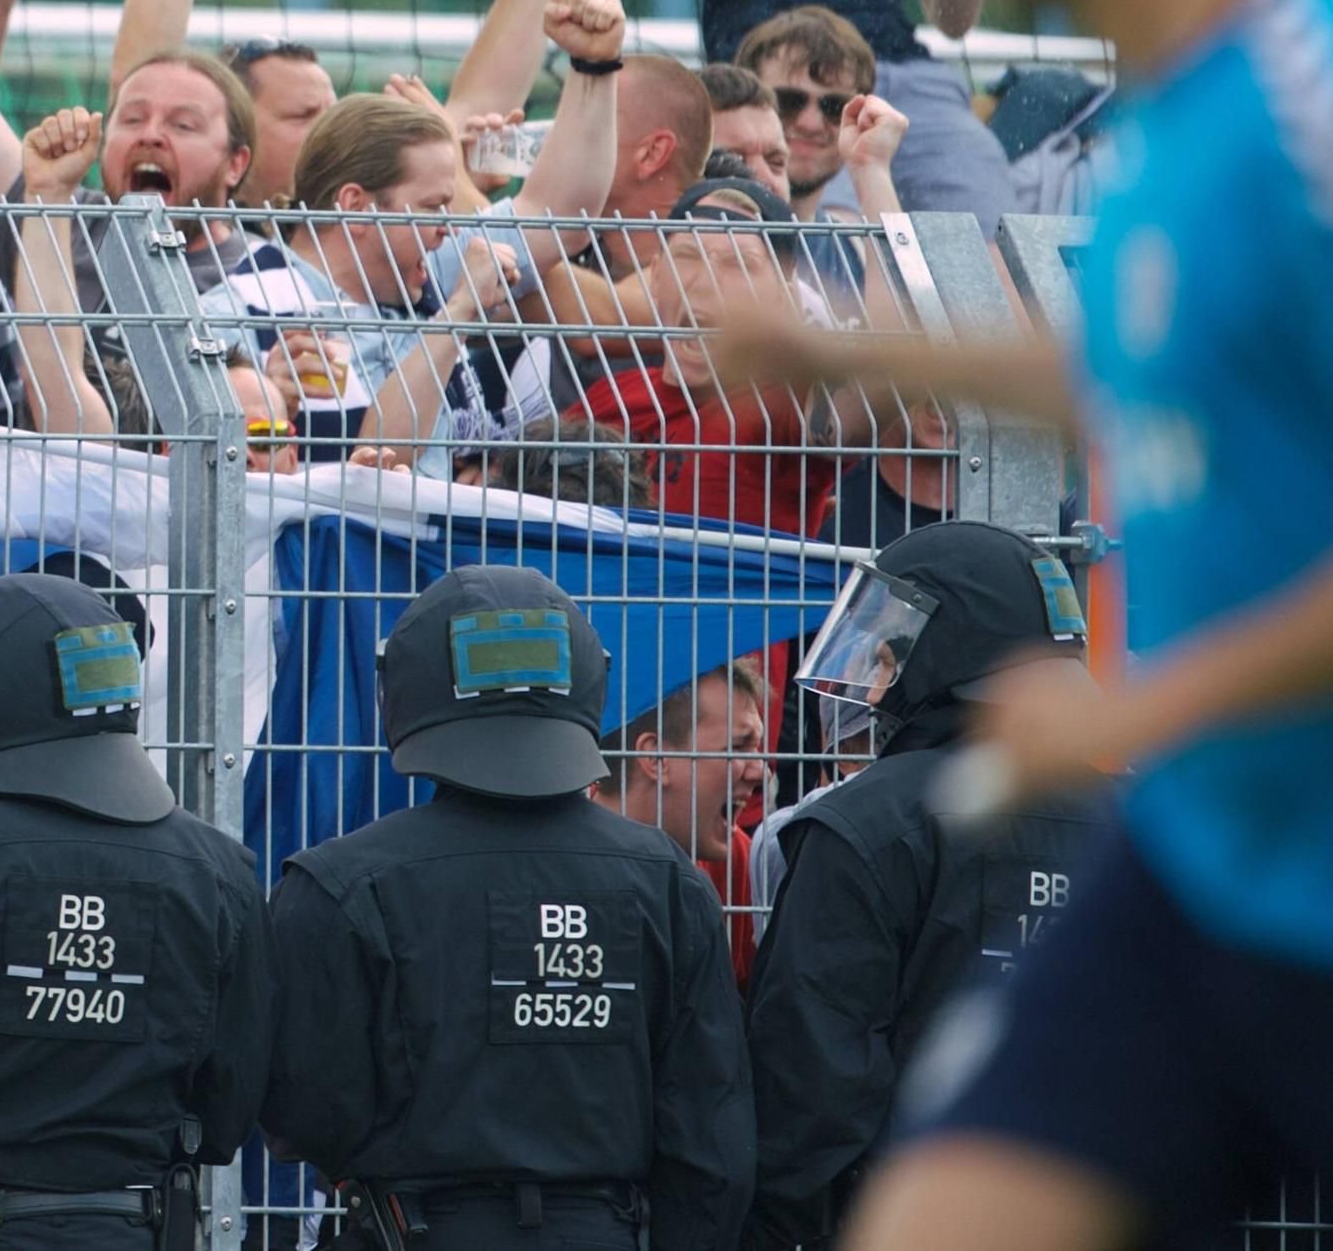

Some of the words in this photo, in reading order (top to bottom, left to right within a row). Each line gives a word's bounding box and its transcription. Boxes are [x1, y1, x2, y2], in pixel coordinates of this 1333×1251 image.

[1030, 871, 1070, 907] BB
[59, 894, 105, 931] BB
[540, 904, 588, 939] BB
[47, 931, 116, 970] 1433
[533, 943, 604, 979] 1433
[25, 986, 125, 1024] 77940
[514, 993, 611, 1028] 65529
